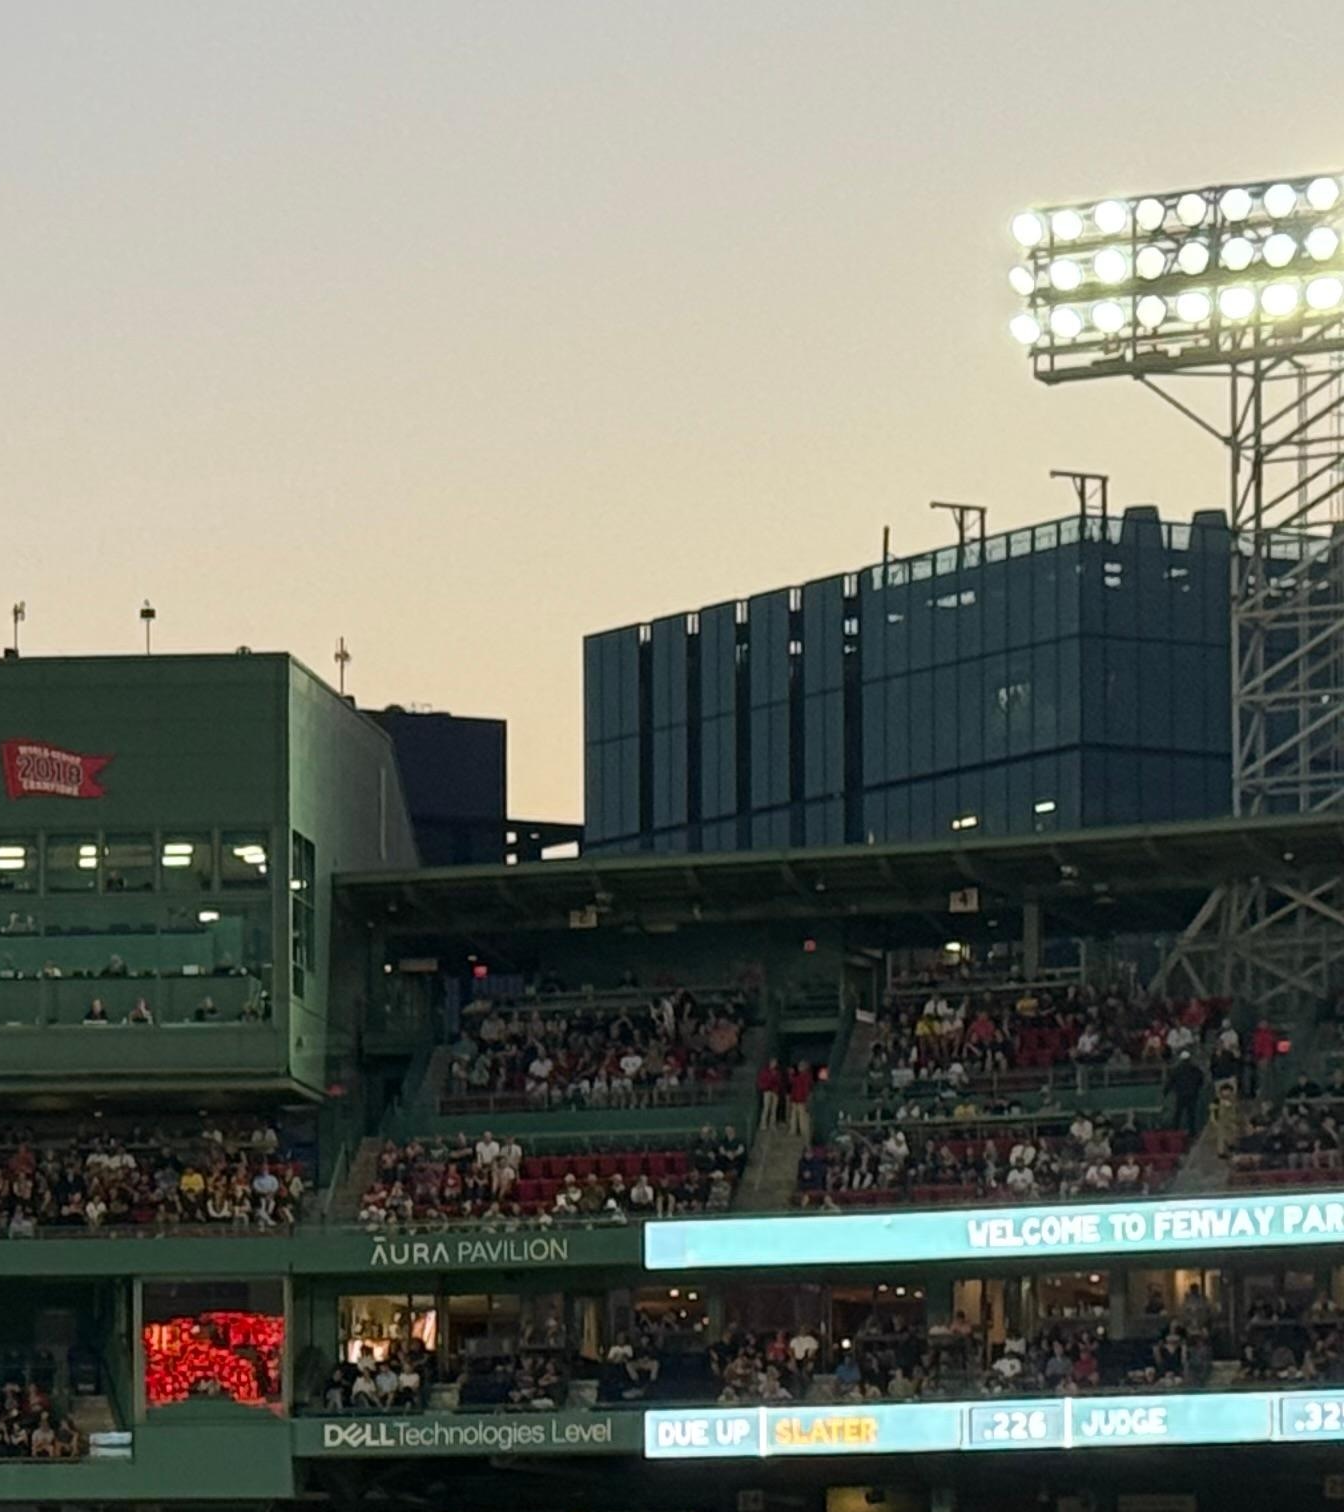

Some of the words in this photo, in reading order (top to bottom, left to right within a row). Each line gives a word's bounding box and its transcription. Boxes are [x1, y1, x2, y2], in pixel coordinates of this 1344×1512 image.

[17, 755, 83, 787] 2018
[967, 1214, 1101, 1247] WELCOME
[1109, 1214, 1147, 1241] TO
[1154, 1206, 1275, 1241] FENWAY
[458, 1239, 568, 1262] PAVILION
[324, 1423, 394, 1447] DELL
[395, 1420, 545, 1450] Technologies
[552, 1418, 611, 1443] Level
[658, 1420, 708, 1447] DUE
[716, 1419, 750, 1445] UP
[775, 1417, 877, 1445] SLATER
[983, 1411, 1047, 1439] .226
[1081, 1407, 1167, 1437] JUDGE
